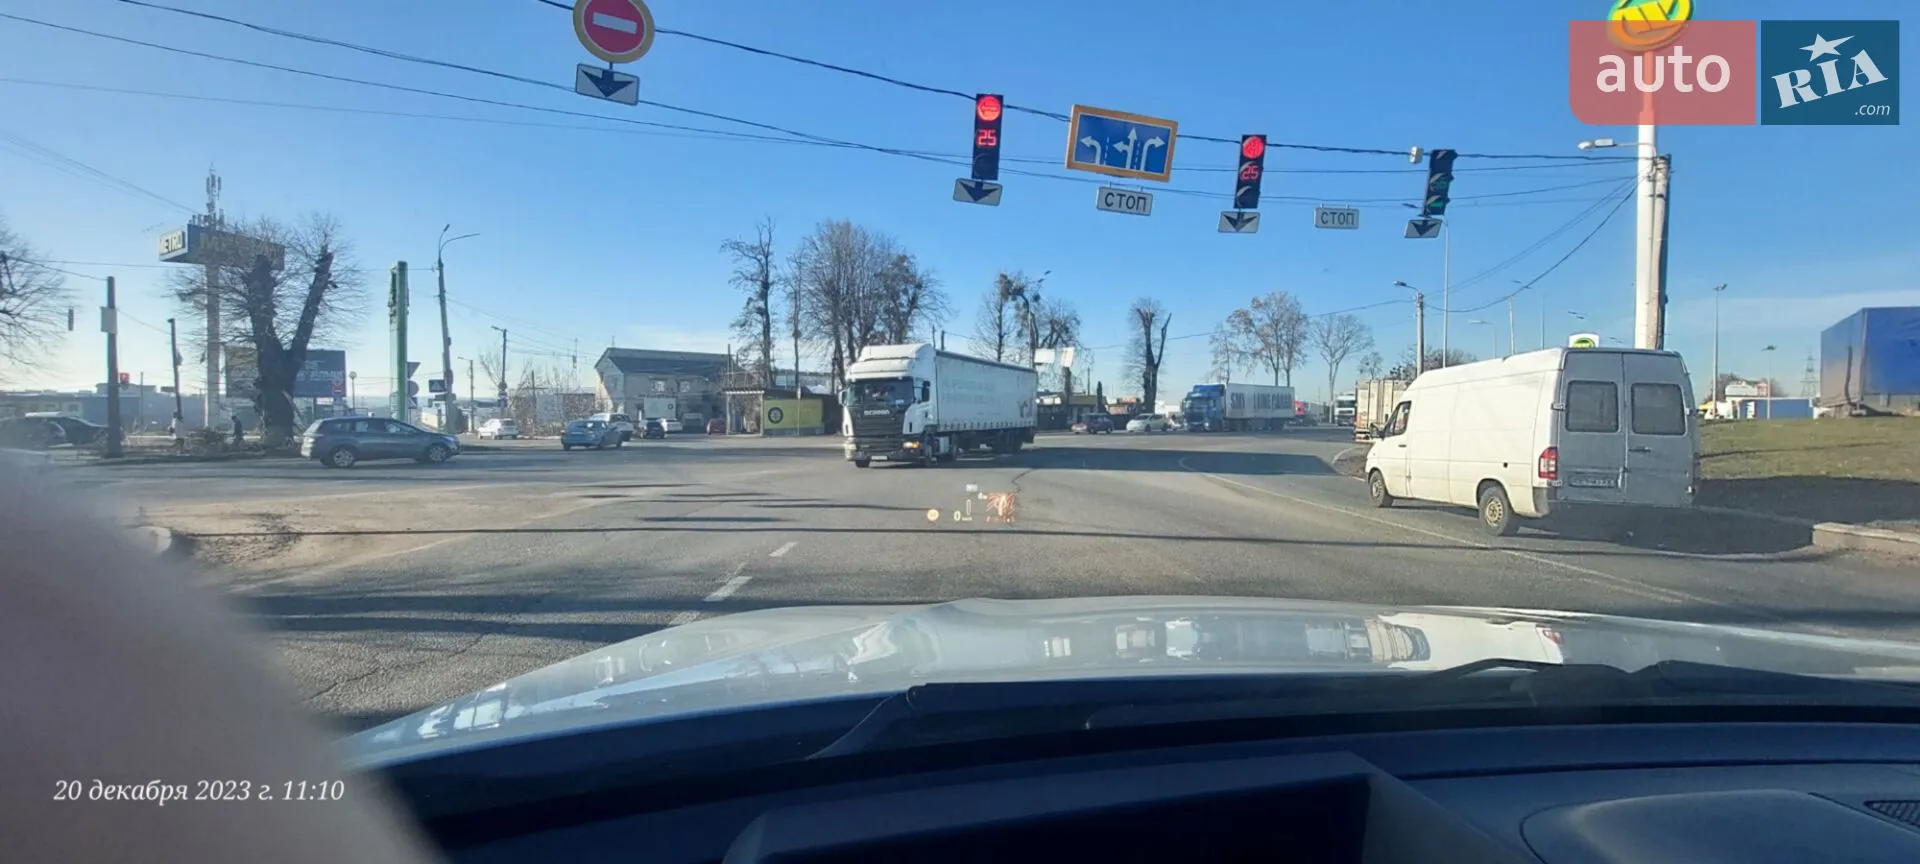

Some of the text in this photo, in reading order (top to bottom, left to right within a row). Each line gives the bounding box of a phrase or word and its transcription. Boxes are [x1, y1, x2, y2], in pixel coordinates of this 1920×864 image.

[978, 129, 997, 146] 25
[1242, 165, 1260, 180] 25
[1104, 192, 1148, 212] СТОП
[1320, 211, 1355, 226] СТОП
